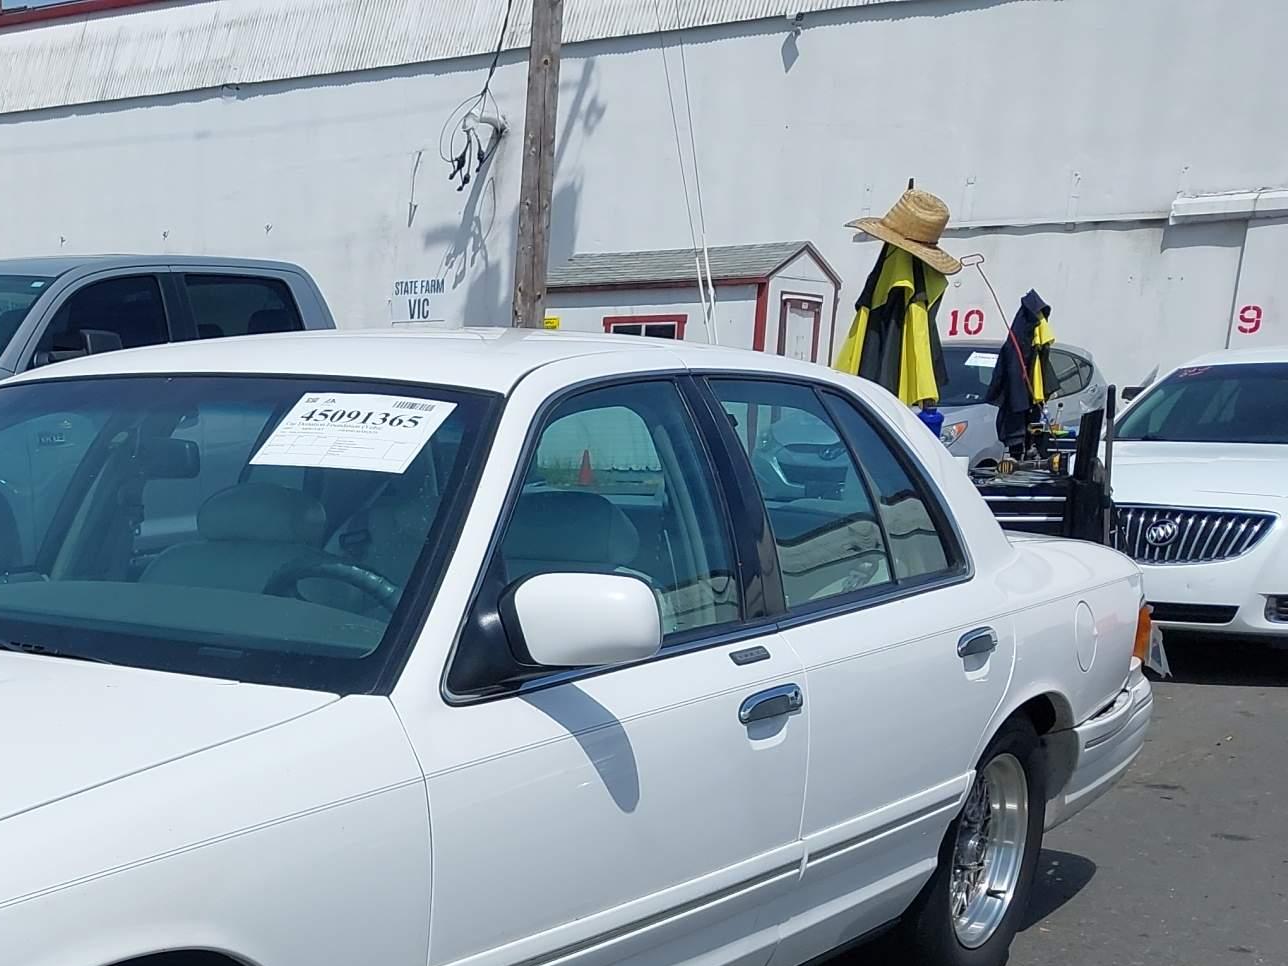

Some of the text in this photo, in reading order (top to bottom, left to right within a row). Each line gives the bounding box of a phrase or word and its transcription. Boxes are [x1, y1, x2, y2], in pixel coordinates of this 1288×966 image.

[394, 278, 445, 296] STATE FARM
[408, 298, 430, 320] VIC
[1237, 304, 1263, 335] 9
[948, 309, 985, 337] 10
[300, 408, 424, 429] 45091365
